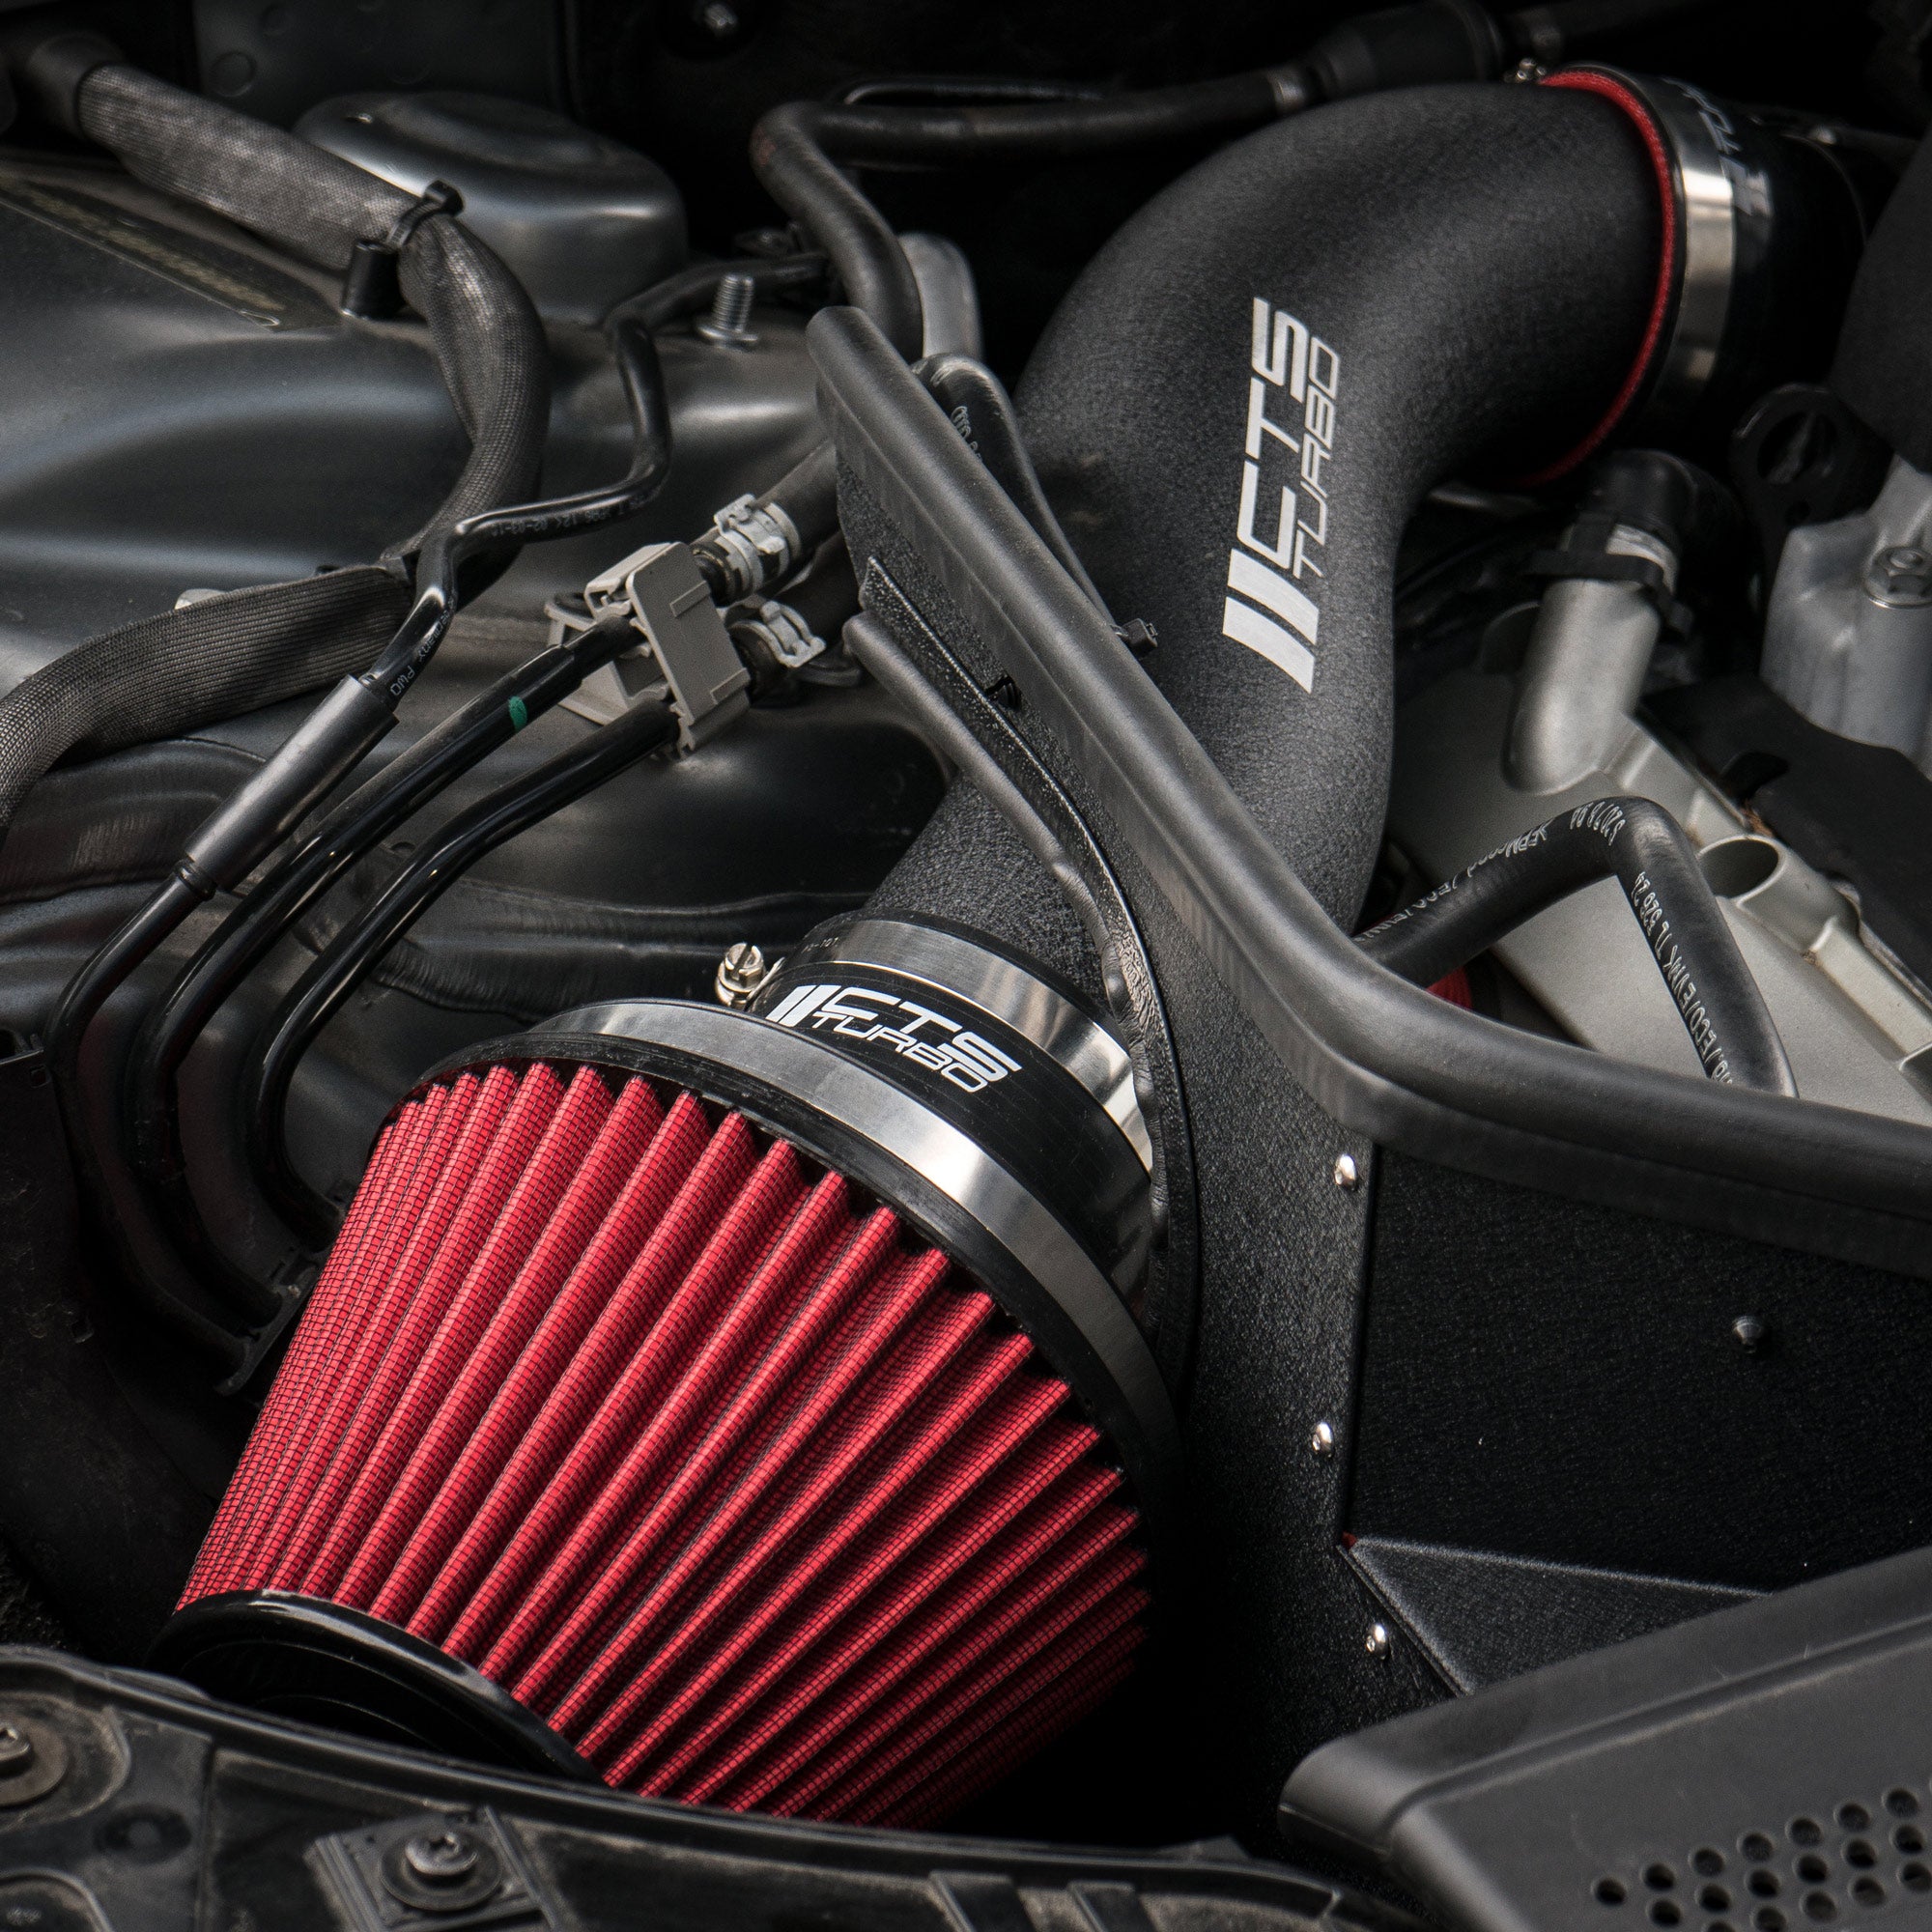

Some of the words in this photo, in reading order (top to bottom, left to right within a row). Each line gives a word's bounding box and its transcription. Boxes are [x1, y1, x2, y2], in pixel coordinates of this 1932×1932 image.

[1236, 297, 1309, 569] CTS
[1292, 336, 1340, 579] TURBO
[389, 665, 415, 696] PWO
[811, 1010, 988, 1094] TURBO
[820, 985, 1023, 1083] CTS
